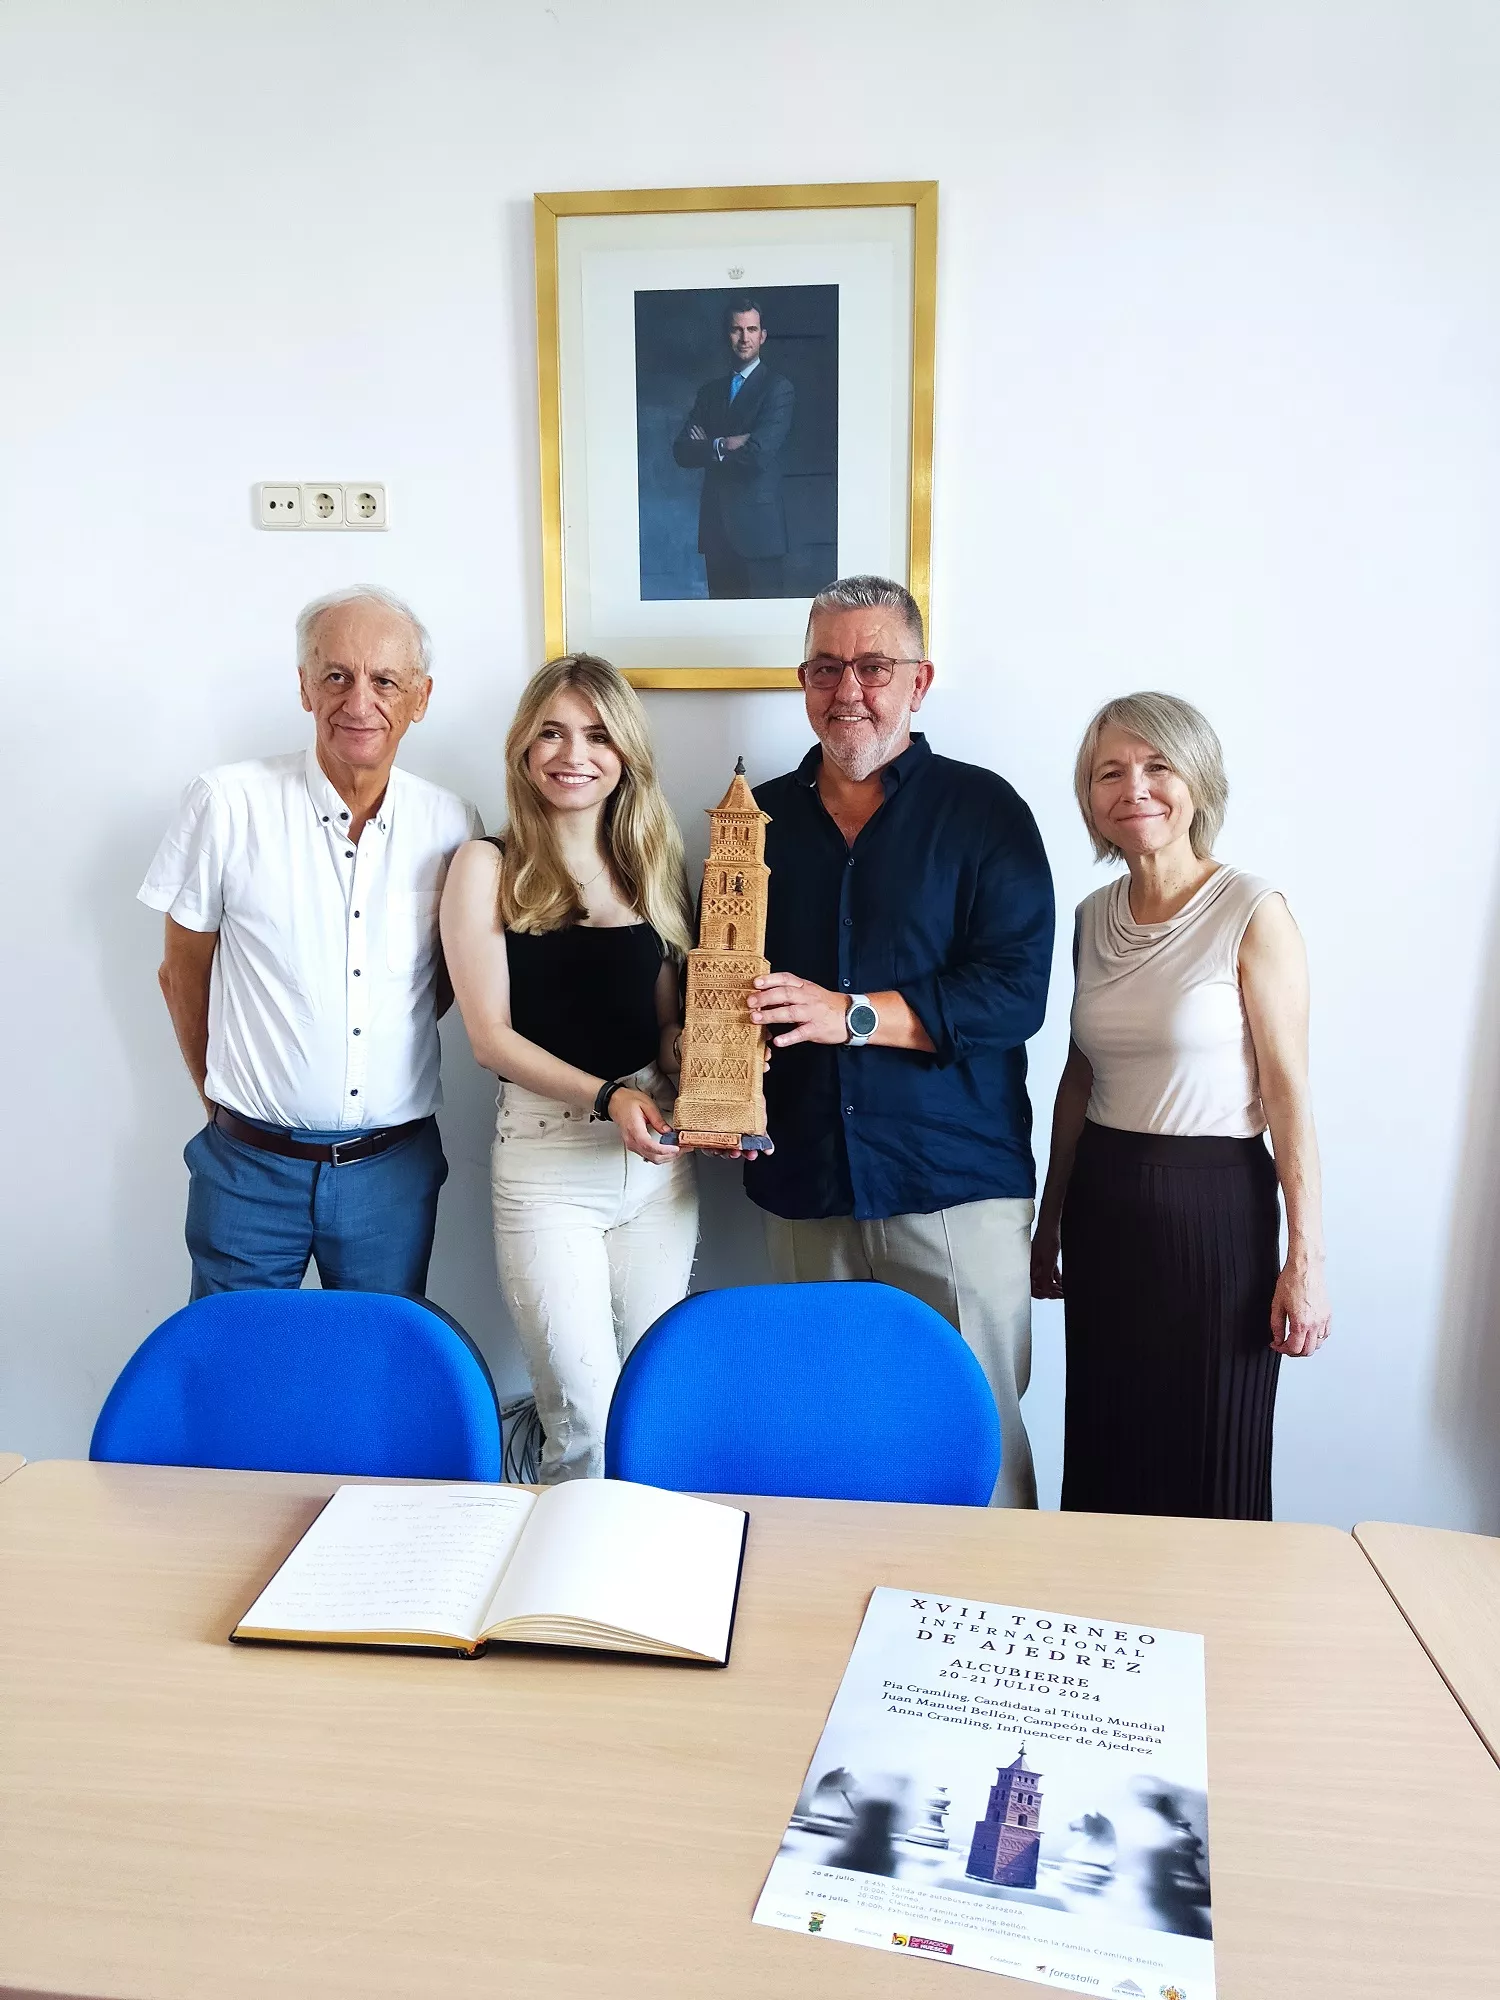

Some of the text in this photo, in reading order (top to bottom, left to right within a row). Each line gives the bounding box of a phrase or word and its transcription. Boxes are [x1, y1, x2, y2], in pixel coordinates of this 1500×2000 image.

[910, 1598, 1155, 1645] XVII TORNEO
[920, 1616, 1145, 1658] INTERNACIONAL
[916, 1629, 1141, 1674] DE AJEDREZ
[939, 1669, 1101, 1702] 20-21 JULIO 2024
[949, 1658, 1090, 1688] ALCUBIERRE
[881, 1692, 1162, 1744] Juan Manuel Bellón, Campeón de España
[882, 1680, 903, 1690] Pia
[906, 1684, 970, 1703] Cramling,
[974, 1695, 1041, 1713] Candidata
[1107, 1716, 1166, 1733] Mundial
[887, 1705, 1153, 1755] Anna Cramling, Influencer de Ajedrez
[891, 1885, 915, 1895] Salida
[929, 1893, 971, 1906] autobuses
[929, 1907, 958, 1918] Familia
[944, 1918, 979, 1931] partidas
[1033, 1936, 1049, 1945] con
[1051, 1939, 1059, 1947] la
[1061, 1942, 1091, 1953] familia
[1049, 1967, 1100, 1986] forestalia
